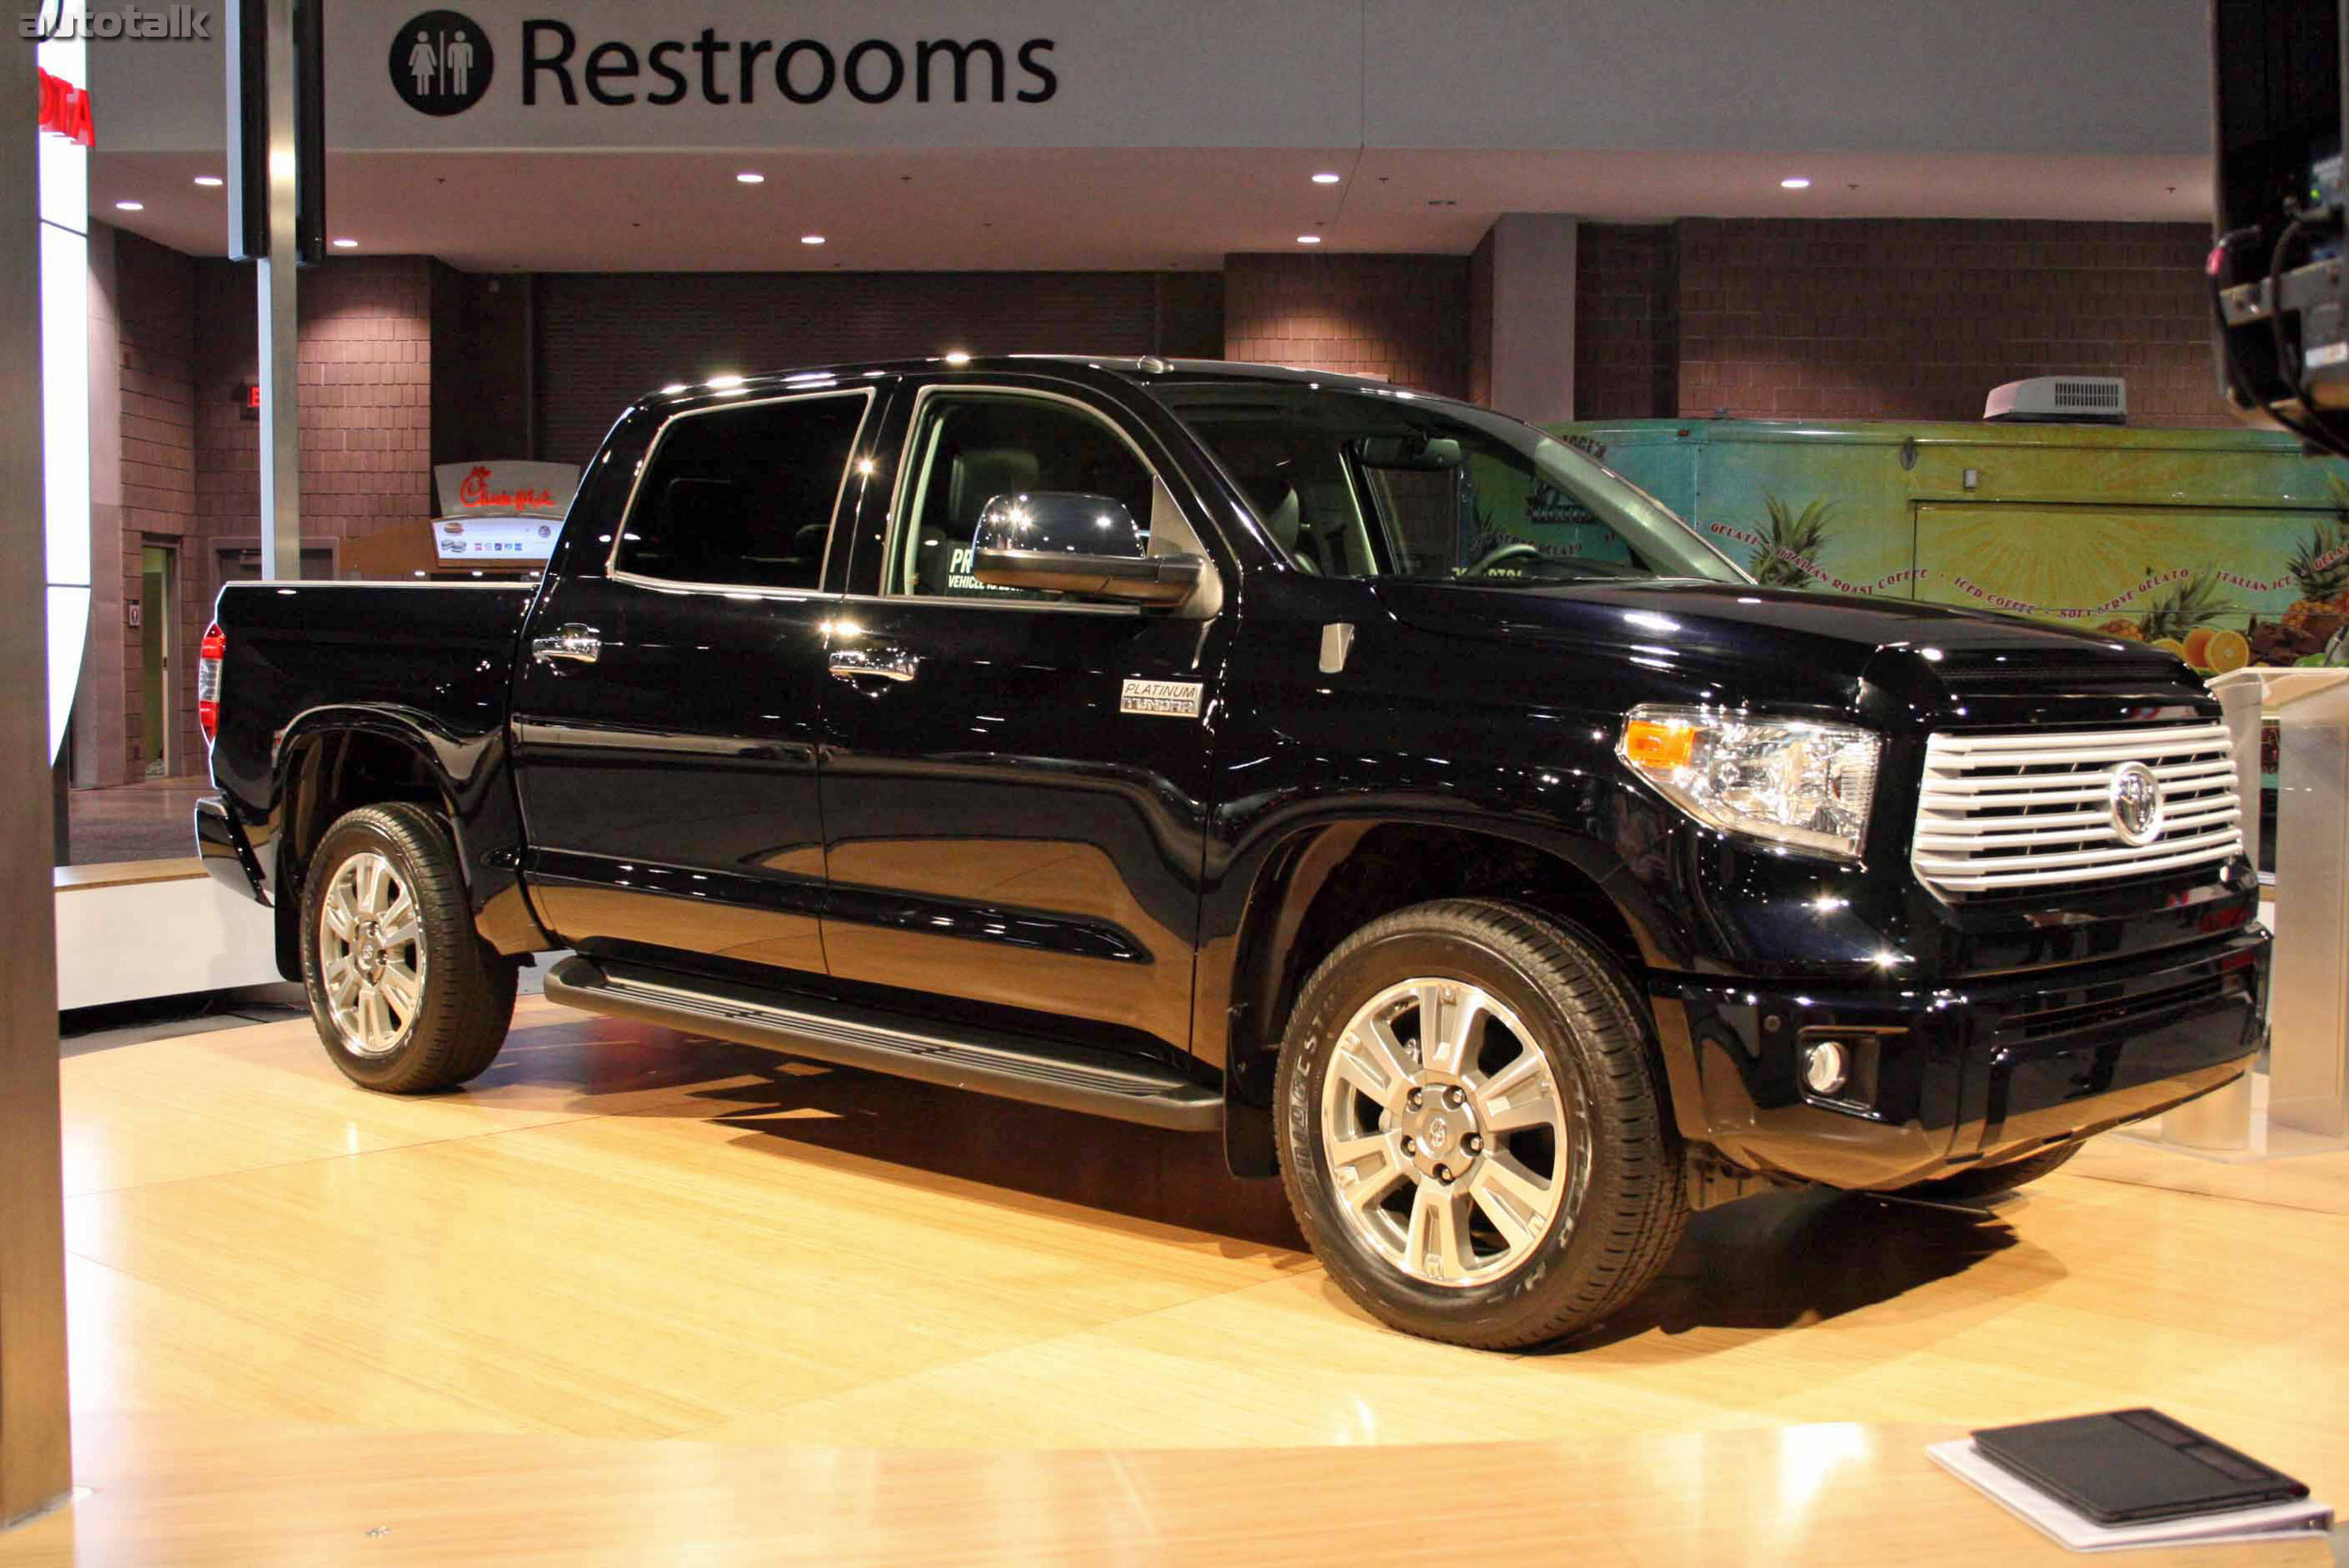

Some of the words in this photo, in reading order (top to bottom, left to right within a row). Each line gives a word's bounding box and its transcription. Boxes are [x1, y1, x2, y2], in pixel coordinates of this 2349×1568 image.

[520, 19, 1059, 105] Restrooms
[1878, 567, 1930, 590] COFFEE
[1953, 576, 1984, 599] ICED
[1986, 593, 2037, 616] COFFEE
[2138, 567, 2191, 594] GELATO
[1125, 683, 1196, 698] PLATINUM
